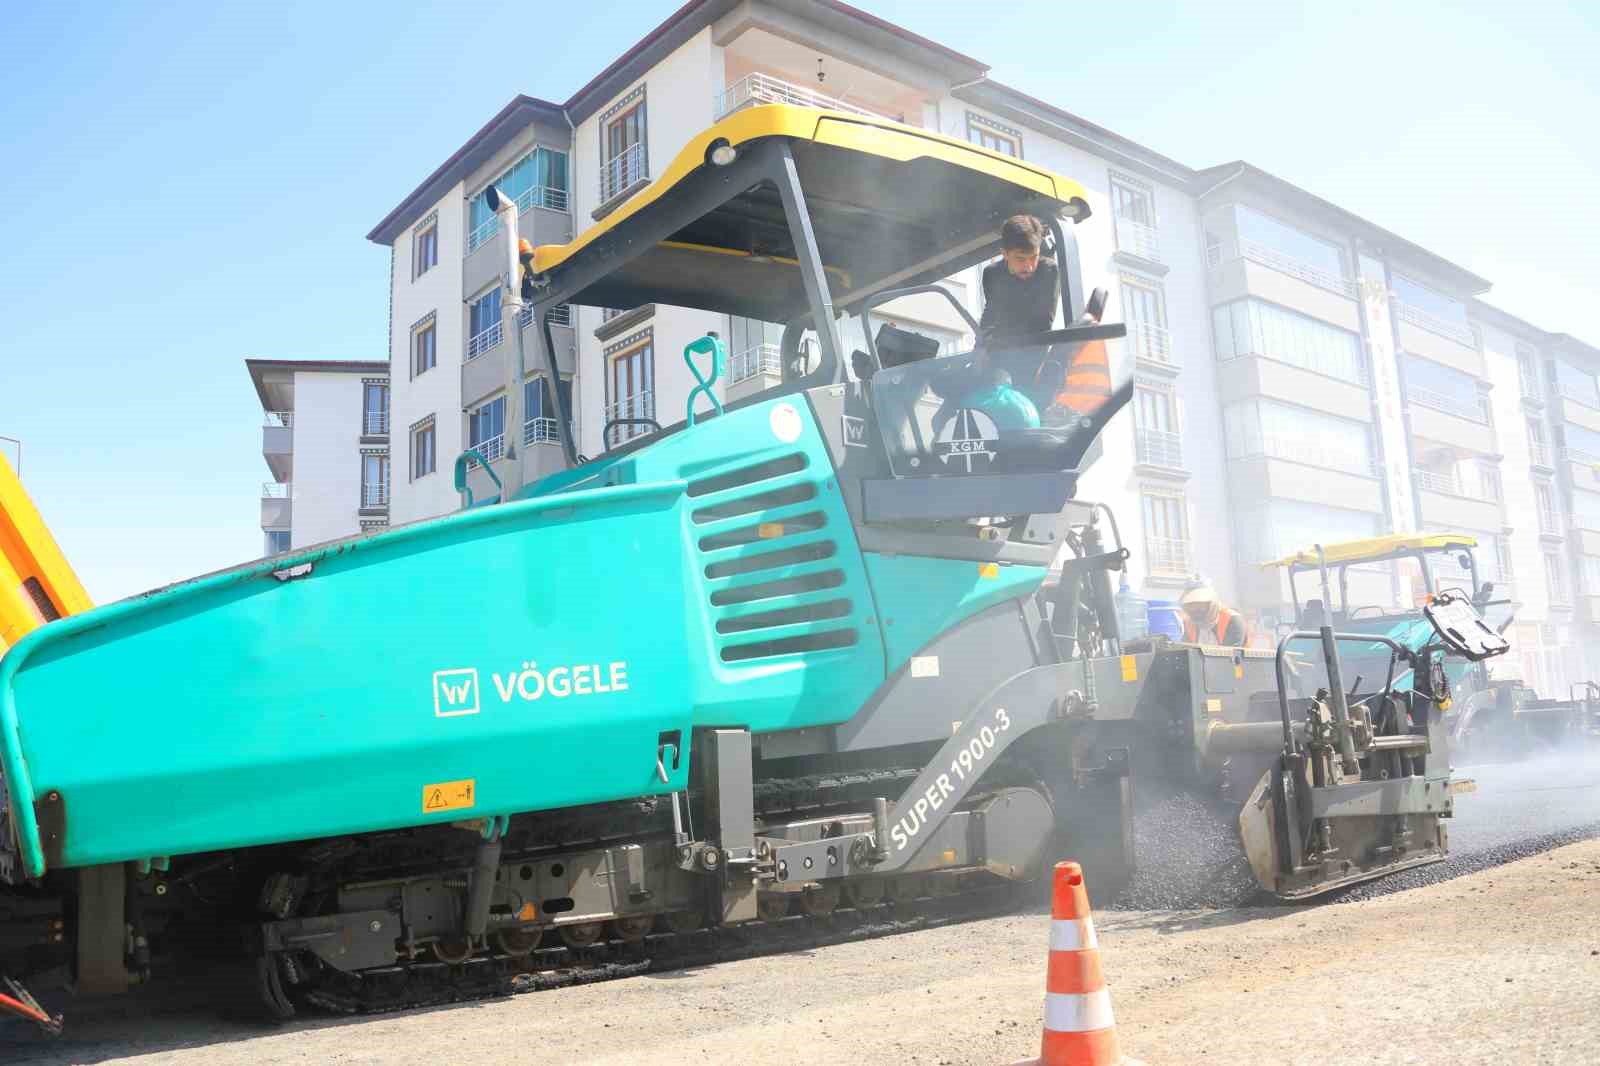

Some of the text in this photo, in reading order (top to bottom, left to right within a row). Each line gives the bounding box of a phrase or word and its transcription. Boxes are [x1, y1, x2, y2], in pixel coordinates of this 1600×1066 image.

[950, 441, 985, 452] KGM
[493, 660, 629, 702] VÖGELE
[891, 708, 1011, 851] SUPER 1900-3
